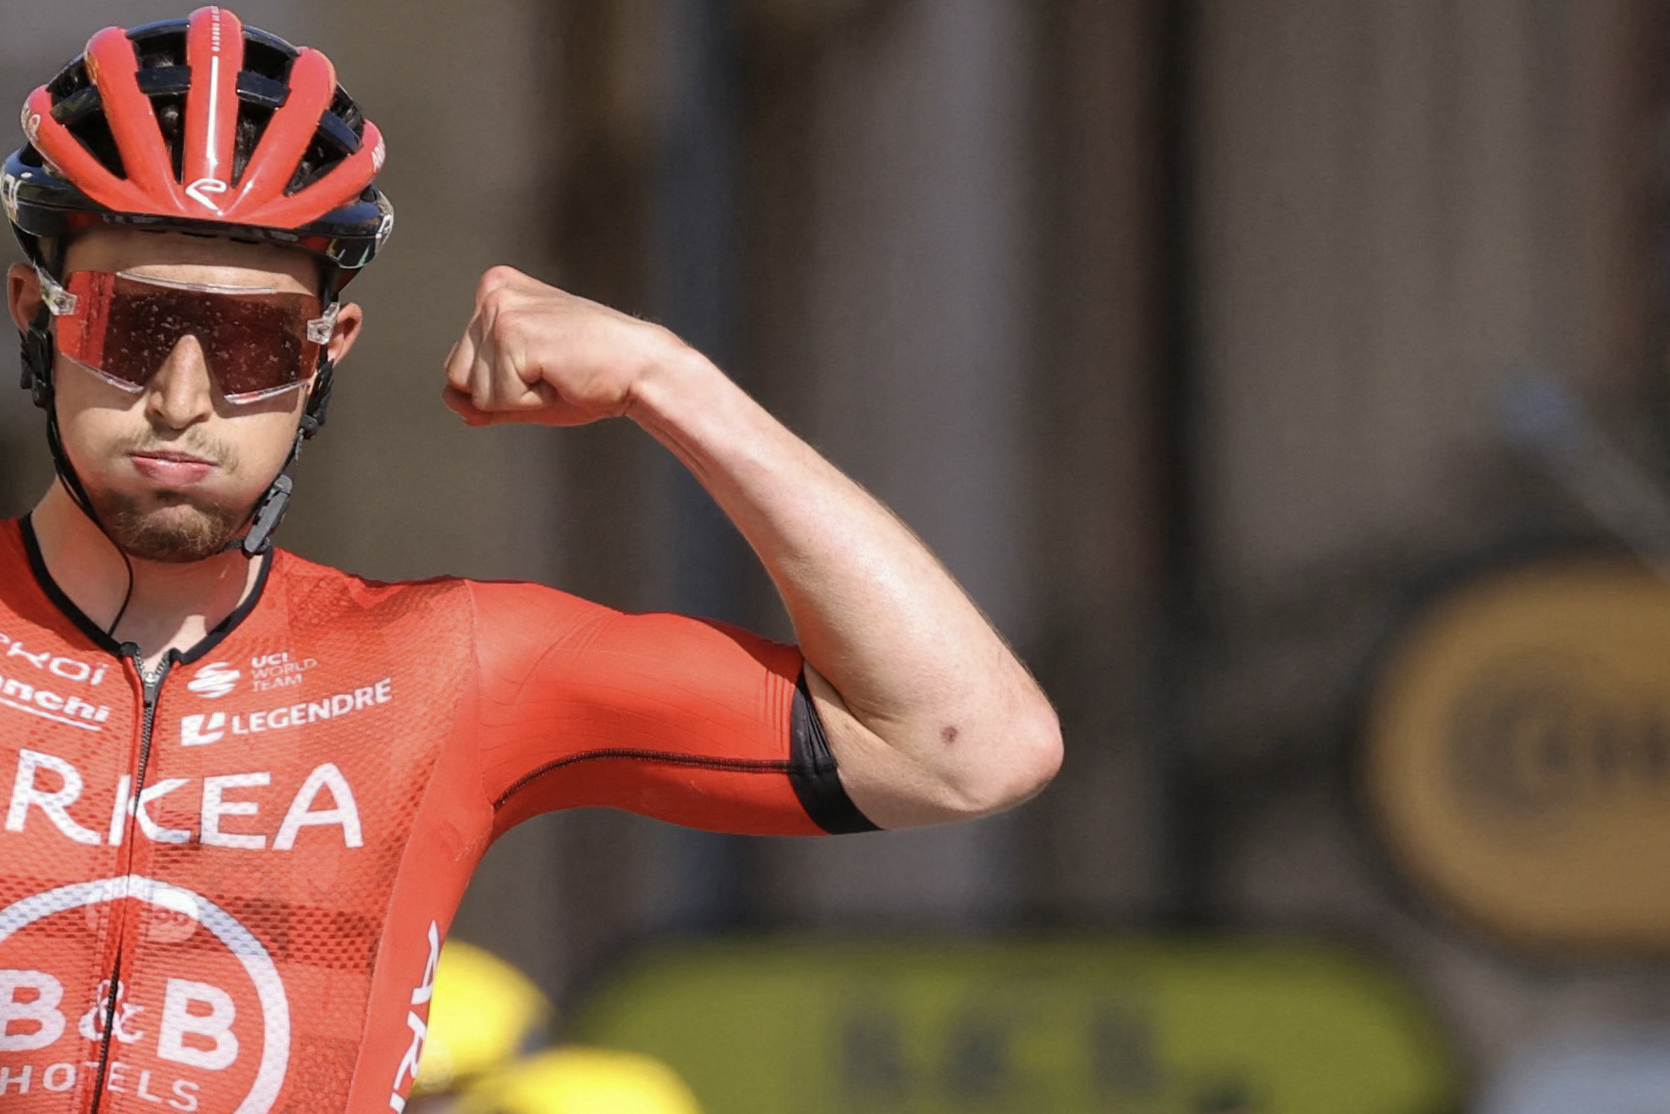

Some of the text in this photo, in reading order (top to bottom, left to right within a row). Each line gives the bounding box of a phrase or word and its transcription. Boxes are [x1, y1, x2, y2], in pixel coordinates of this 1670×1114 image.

[250, 652, 289, 668] UCI
[251, 657, 319, 680] WORLD
[251, 673, 303, 692] TEAM
[231, 677, 393, 735] LEGENDRE
